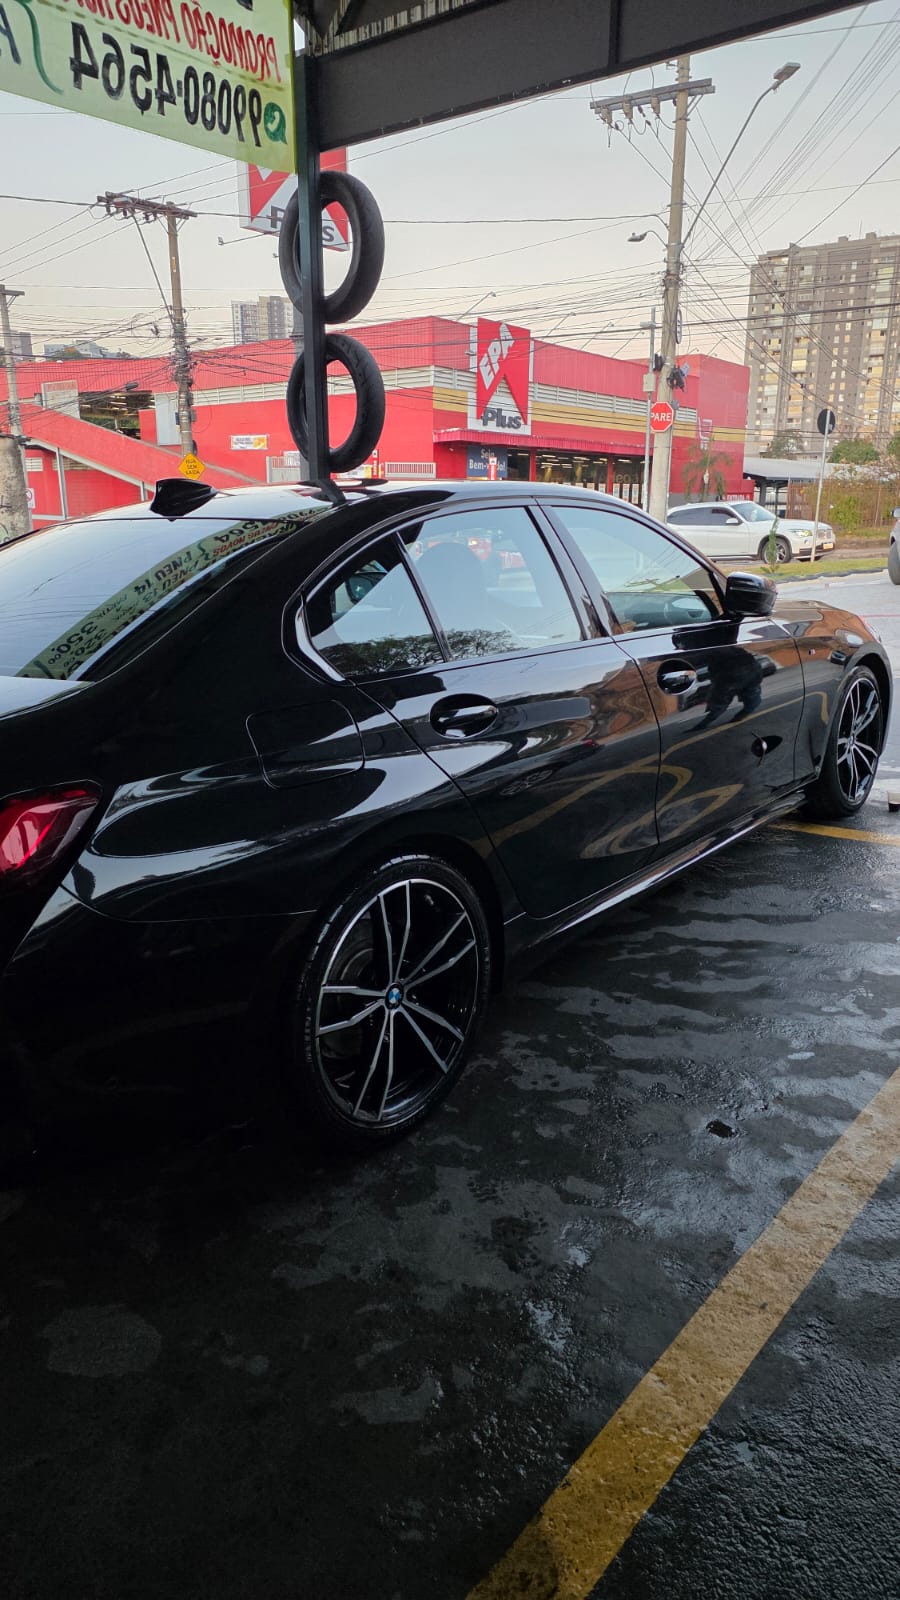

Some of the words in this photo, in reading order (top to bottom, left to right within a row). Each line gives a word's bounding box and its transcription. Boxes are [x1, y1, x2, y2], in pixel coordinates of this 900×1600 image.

[479, 322, 515, 390] EPA
[481, 407, 522, 430] Plus
[650, 412, 672, 423] PARE
[154, 550, 192, 582] PNEU
